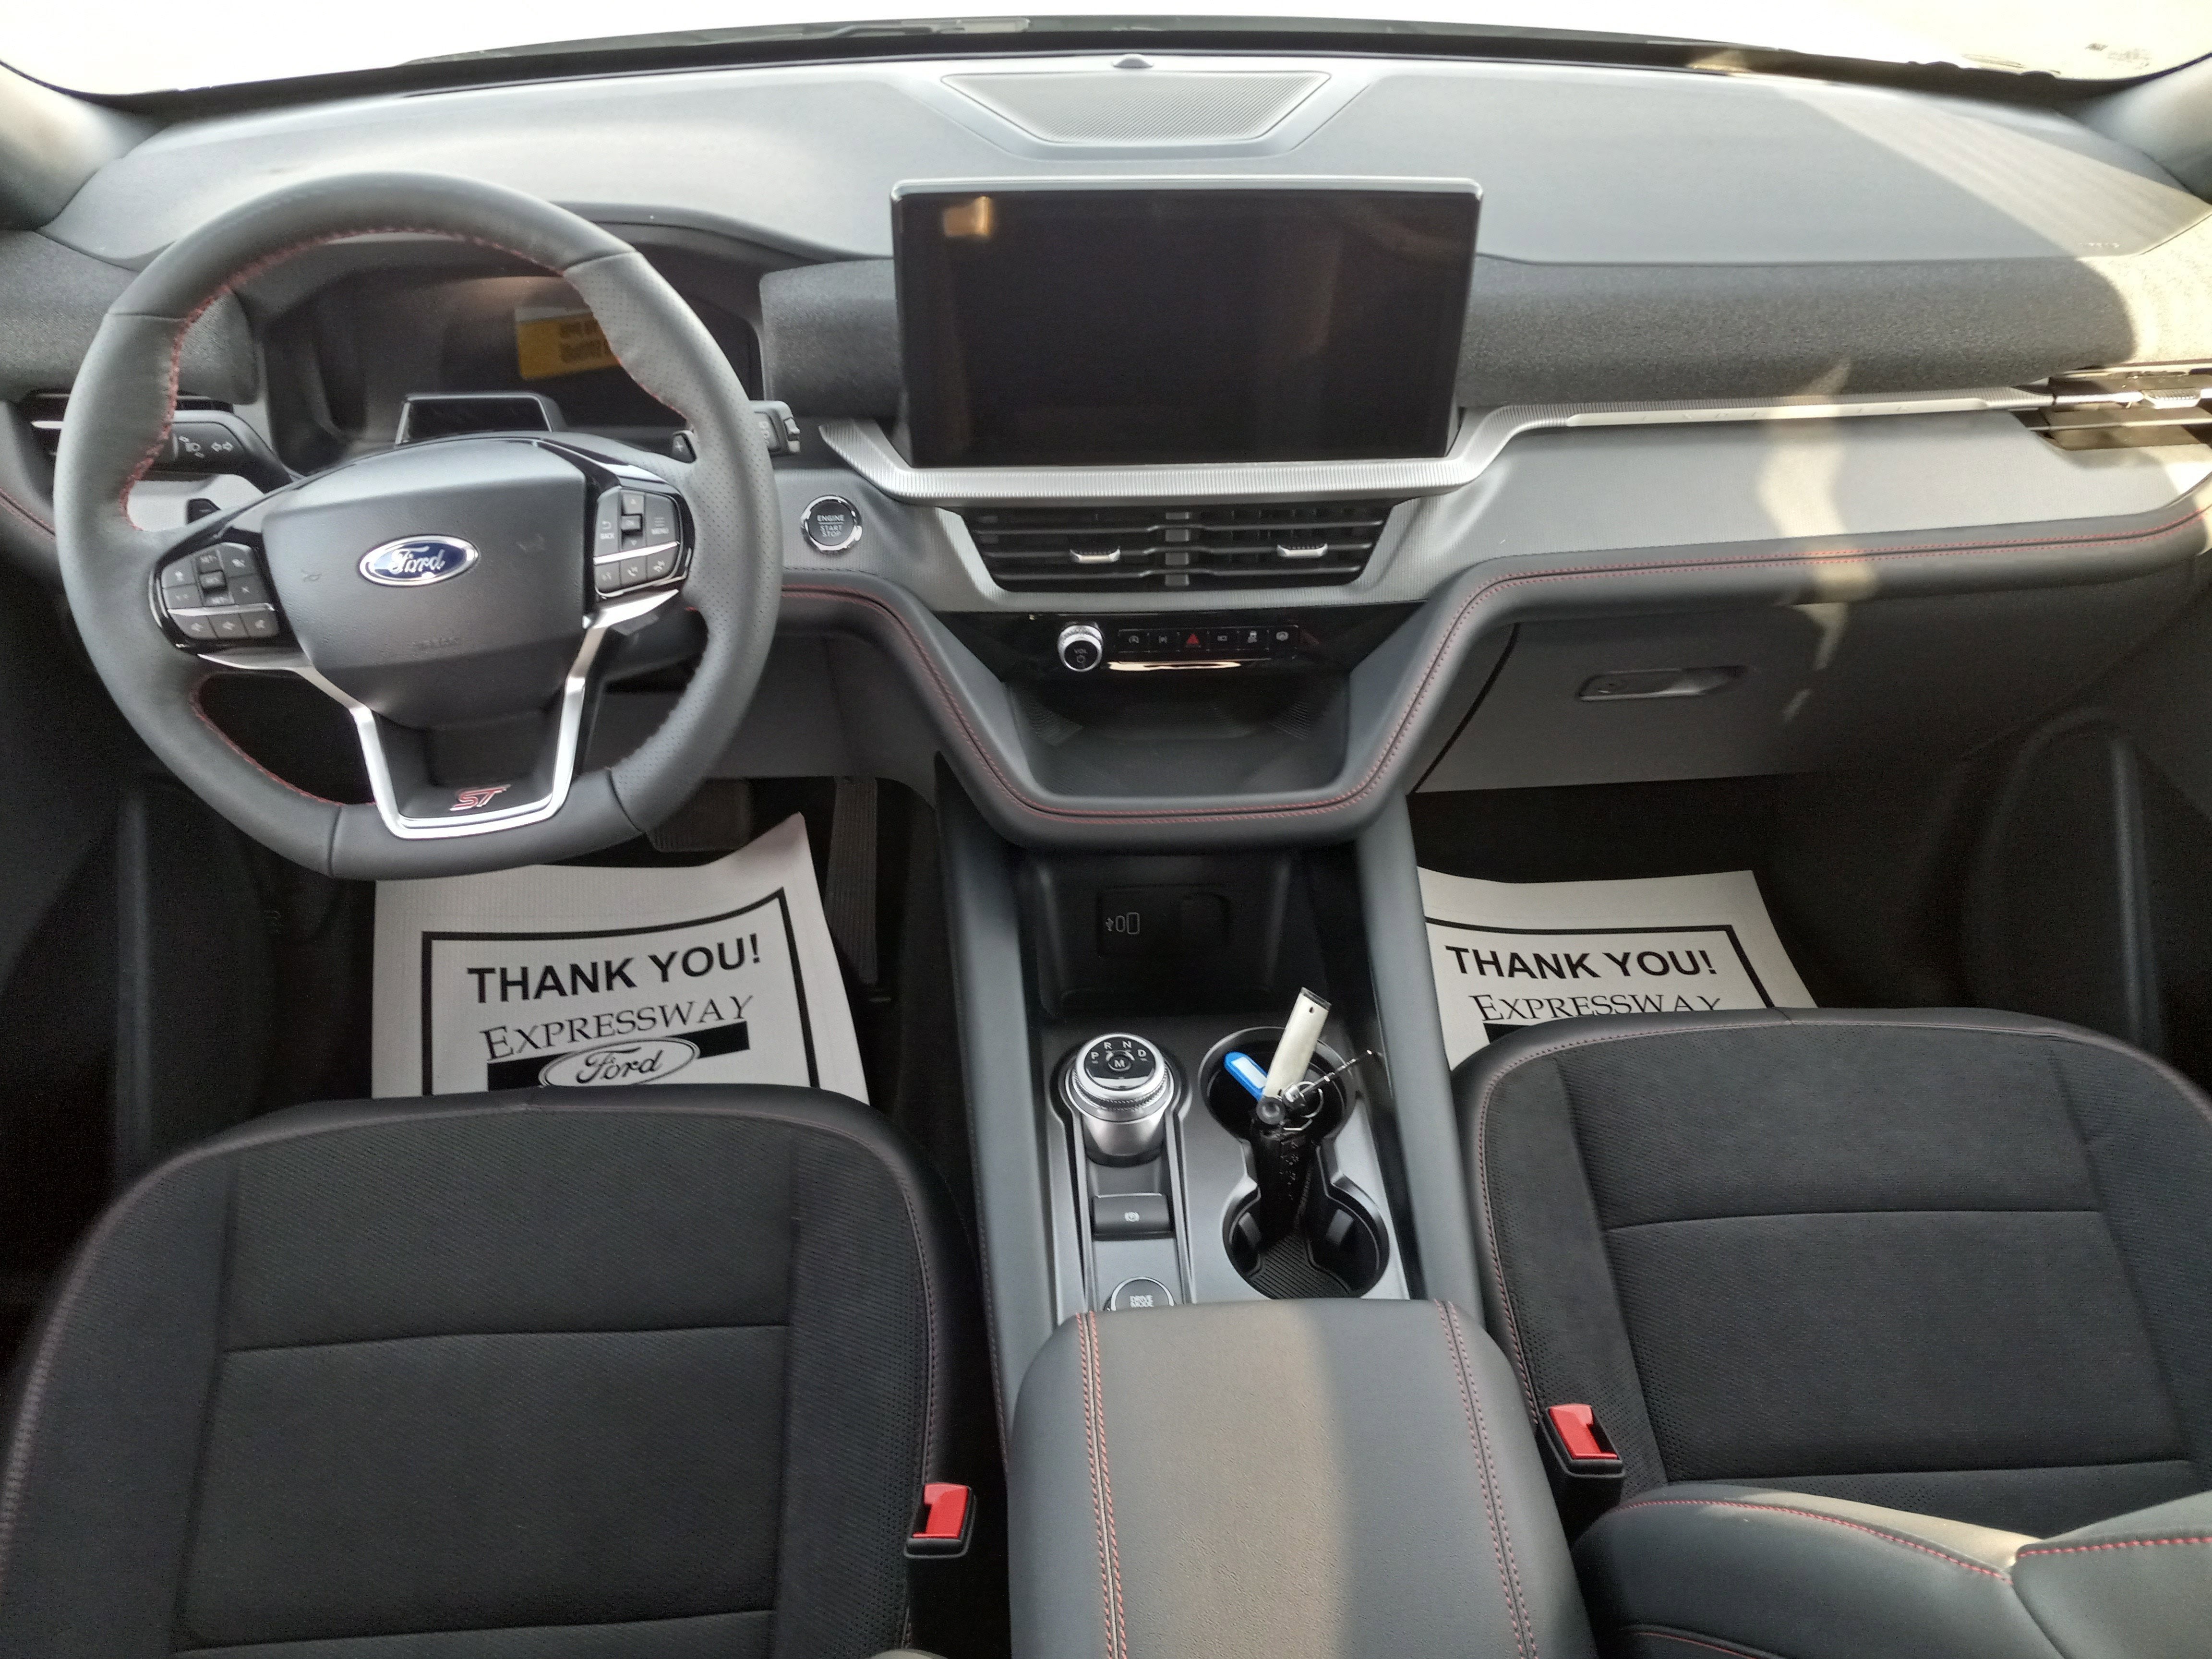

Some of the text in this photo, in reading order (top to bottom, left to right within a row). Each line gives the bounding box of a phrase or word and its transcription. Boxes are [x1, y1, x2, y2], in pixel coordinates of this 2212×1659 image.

[386, 545, 445, 575] Ford
[449, 784, 511, 811] ST
[466, 933, 761, 1004] THANK YOU!
[1444, 945, 1717, 979] THANK YOU!
[1468, 993, 1721, 1021] EXPRESSWAY
[479, 994, 754, 1060] EXPRESSWAY
[575, 1046, 663, 1084] Ford
[1114, 1059, 1125, 1068] M
[1137, 1049, 1147, 1057] D
